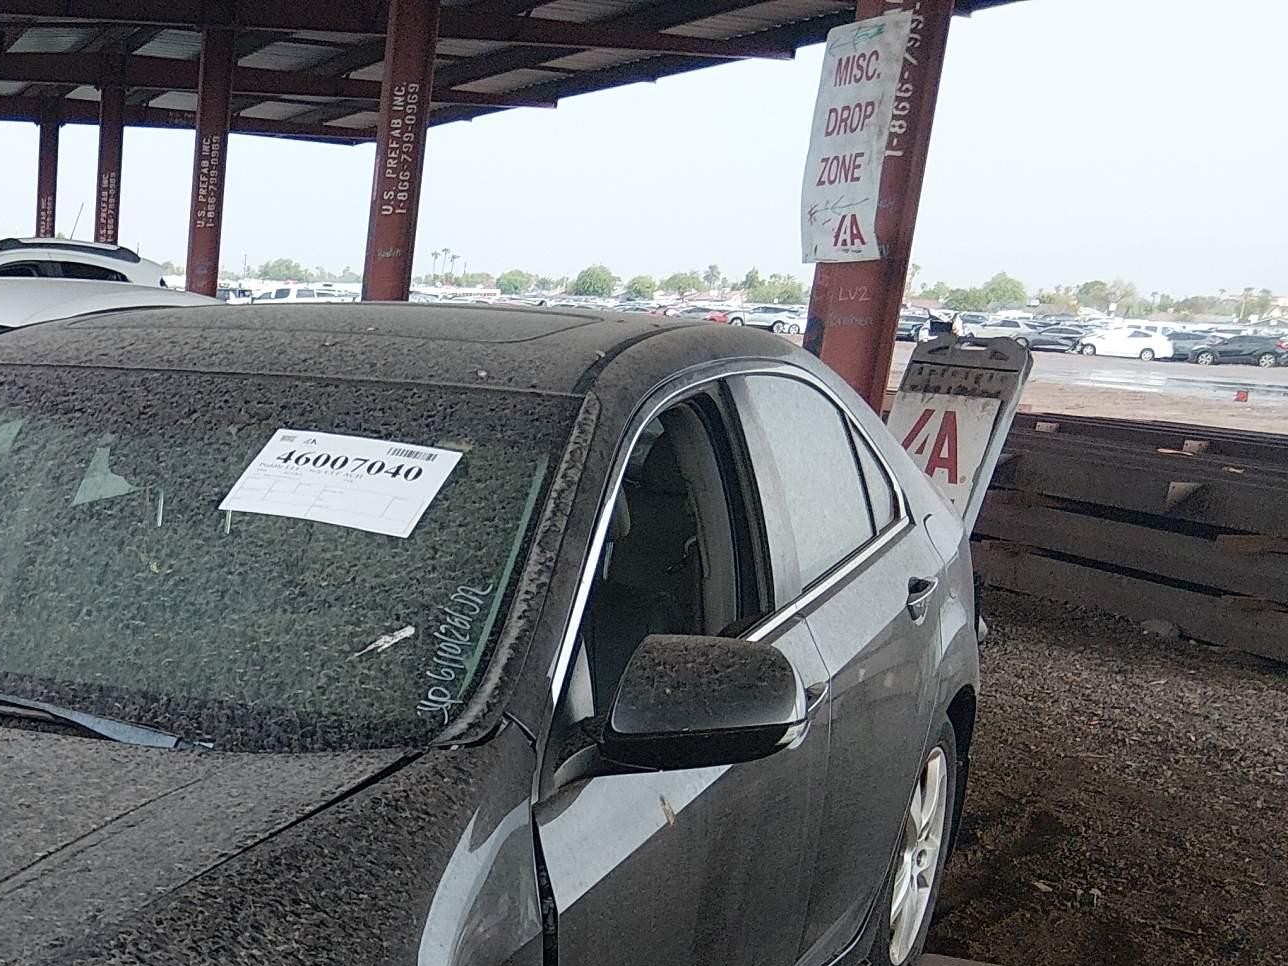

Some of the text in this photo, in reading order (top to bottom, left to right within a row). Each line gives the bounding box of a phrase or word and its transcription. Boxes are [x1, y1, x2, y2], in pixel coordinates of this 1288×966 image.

[833, 49, 881, 87] MISC.
[824, 100, 876, 138] DROP
[381, 81, 407, 215] U.S. PREFAB INC.
[395, 82, 419, 215] 1-866-799-0969
[198, 160, 210, 202] PREFAB
[815, 152, 865, 187] ZONE
[276, 448, 424, 482] 46007040
